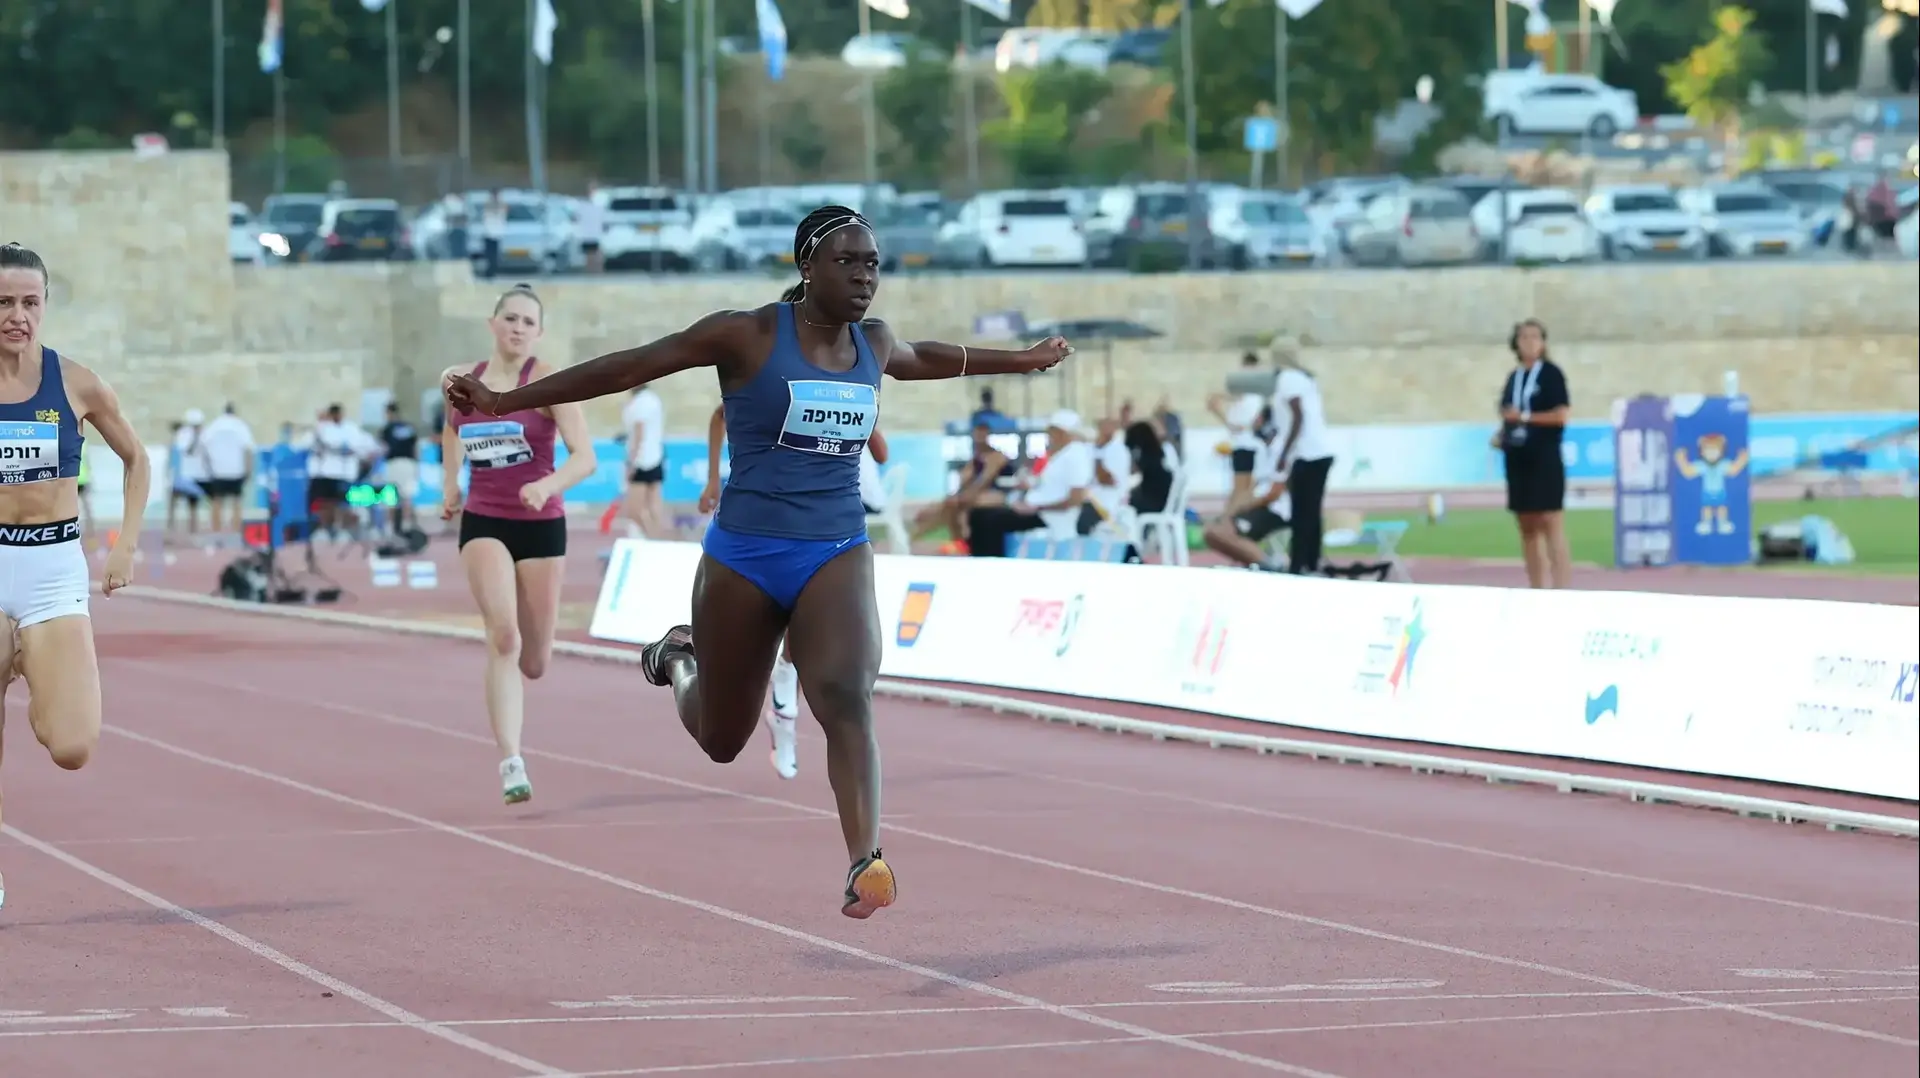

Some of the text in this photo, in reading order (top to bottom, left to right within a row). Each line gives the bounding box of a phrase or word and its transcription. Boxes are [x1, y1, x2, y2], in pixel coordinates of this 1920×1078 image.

[802, 409, 864, 425] אפריפה
[0, 446, 41, 459] דורפ
[816, 441, 841, 453] 2026
[2, 474, 25, 483] 2026
[0, 526, 59, 542] NIKE
